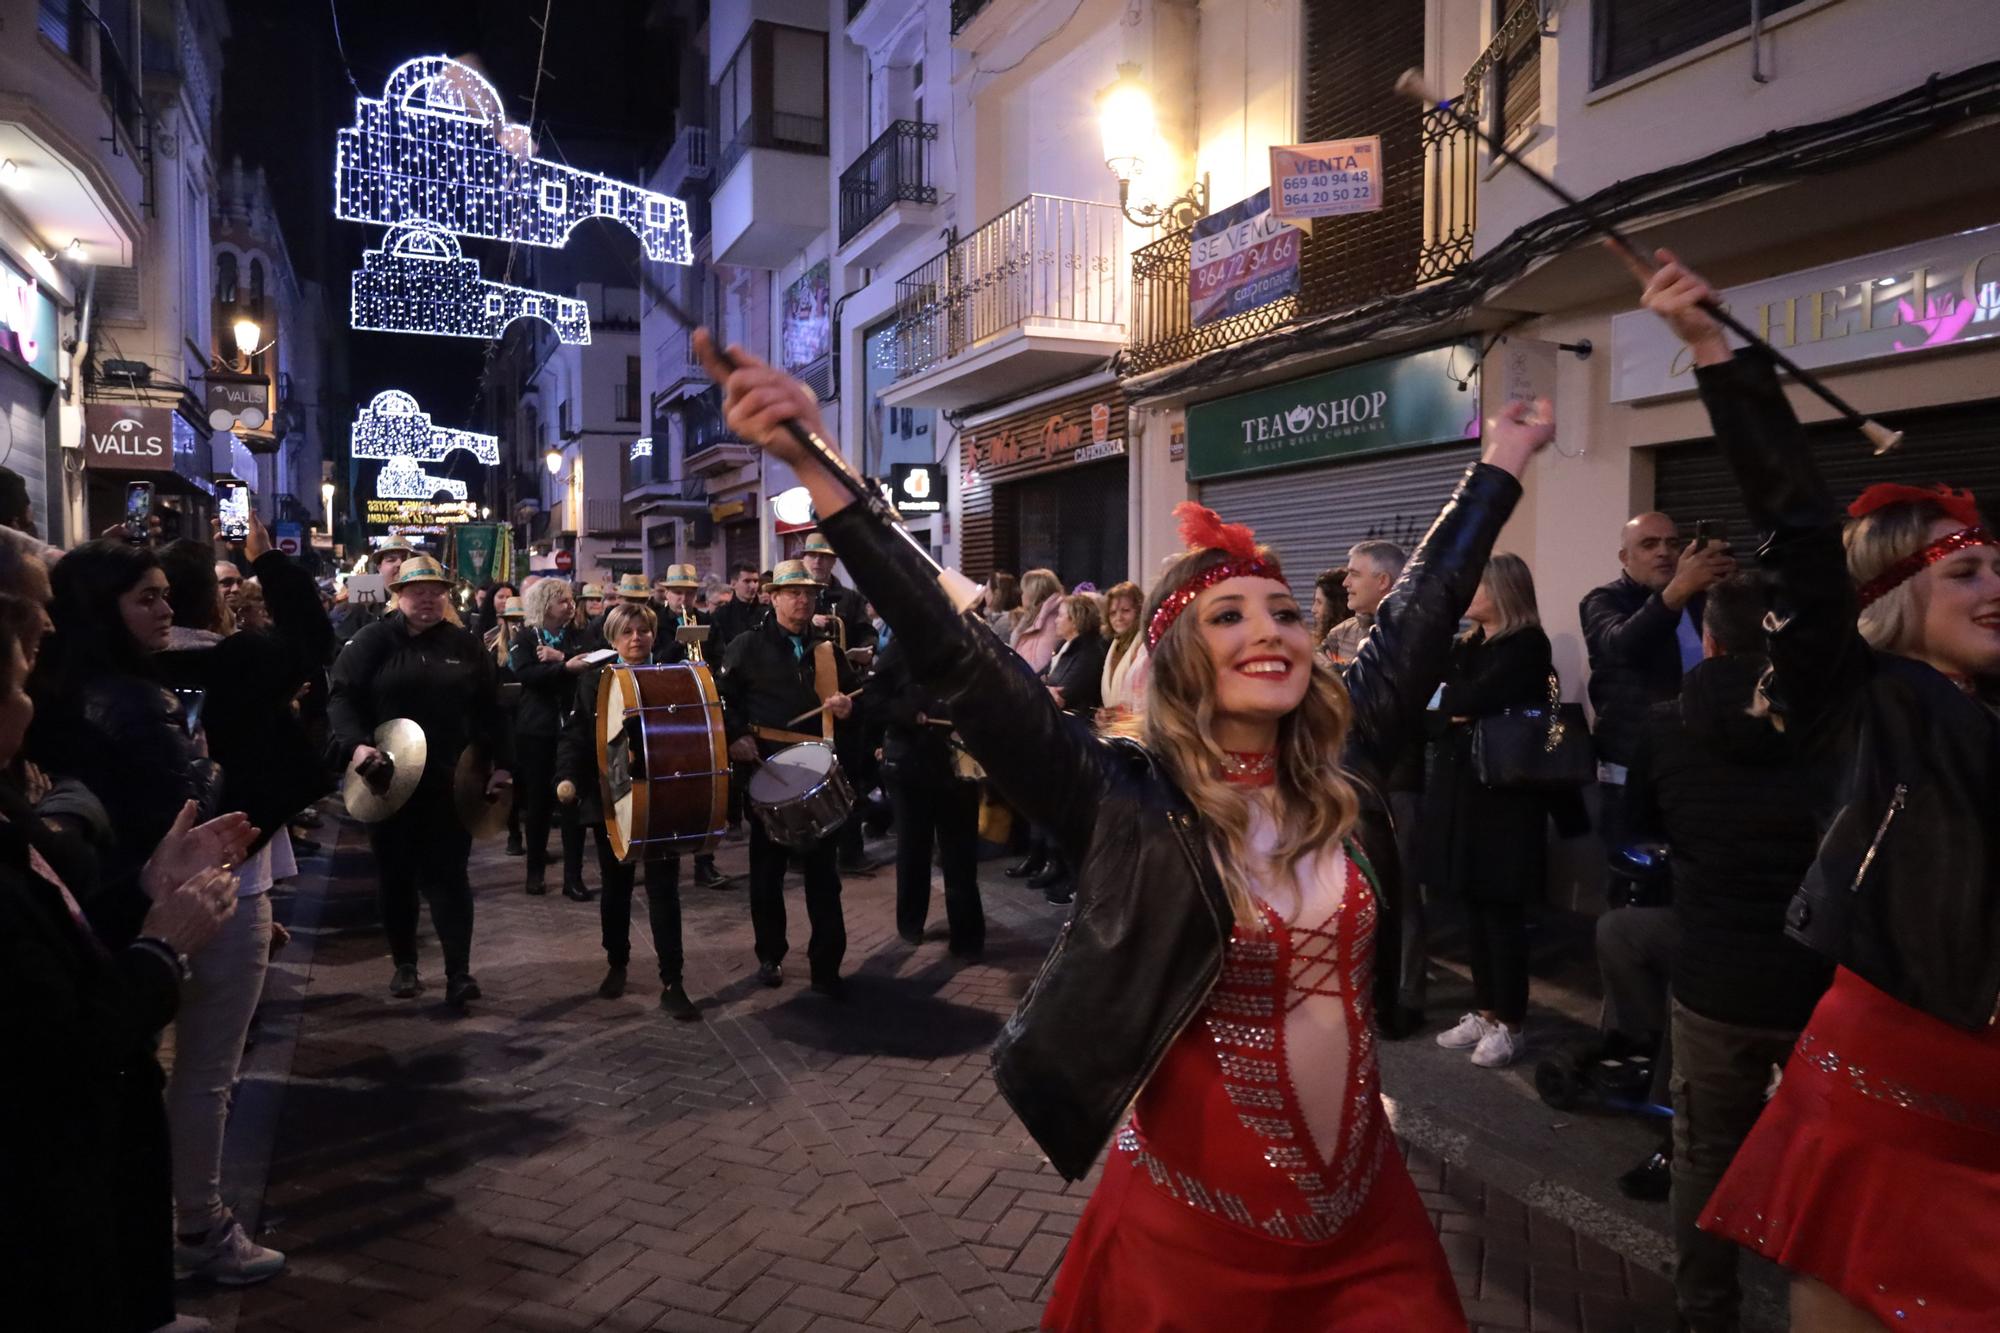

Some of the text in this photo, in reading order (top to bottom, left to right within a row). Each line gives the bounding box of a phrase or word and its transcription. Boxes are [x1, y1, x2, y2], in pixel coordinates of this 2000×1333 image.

[1294, 155, 1358, 174] VENTA
[1283, 170, 1369, 191] 669 40 94 48
[1284, 186, 1370, 206] 964 20 50 22
[1198, 237, 1220, 262] SE
[1249, 243, 1269, 270] 34
[1273, 235, 1292, 261] 66
[227, 390, 264, 404] VALLS
[1241, 390, 1387, 444] TEA SHOP
[92, 434, 163, 456] VALLS
